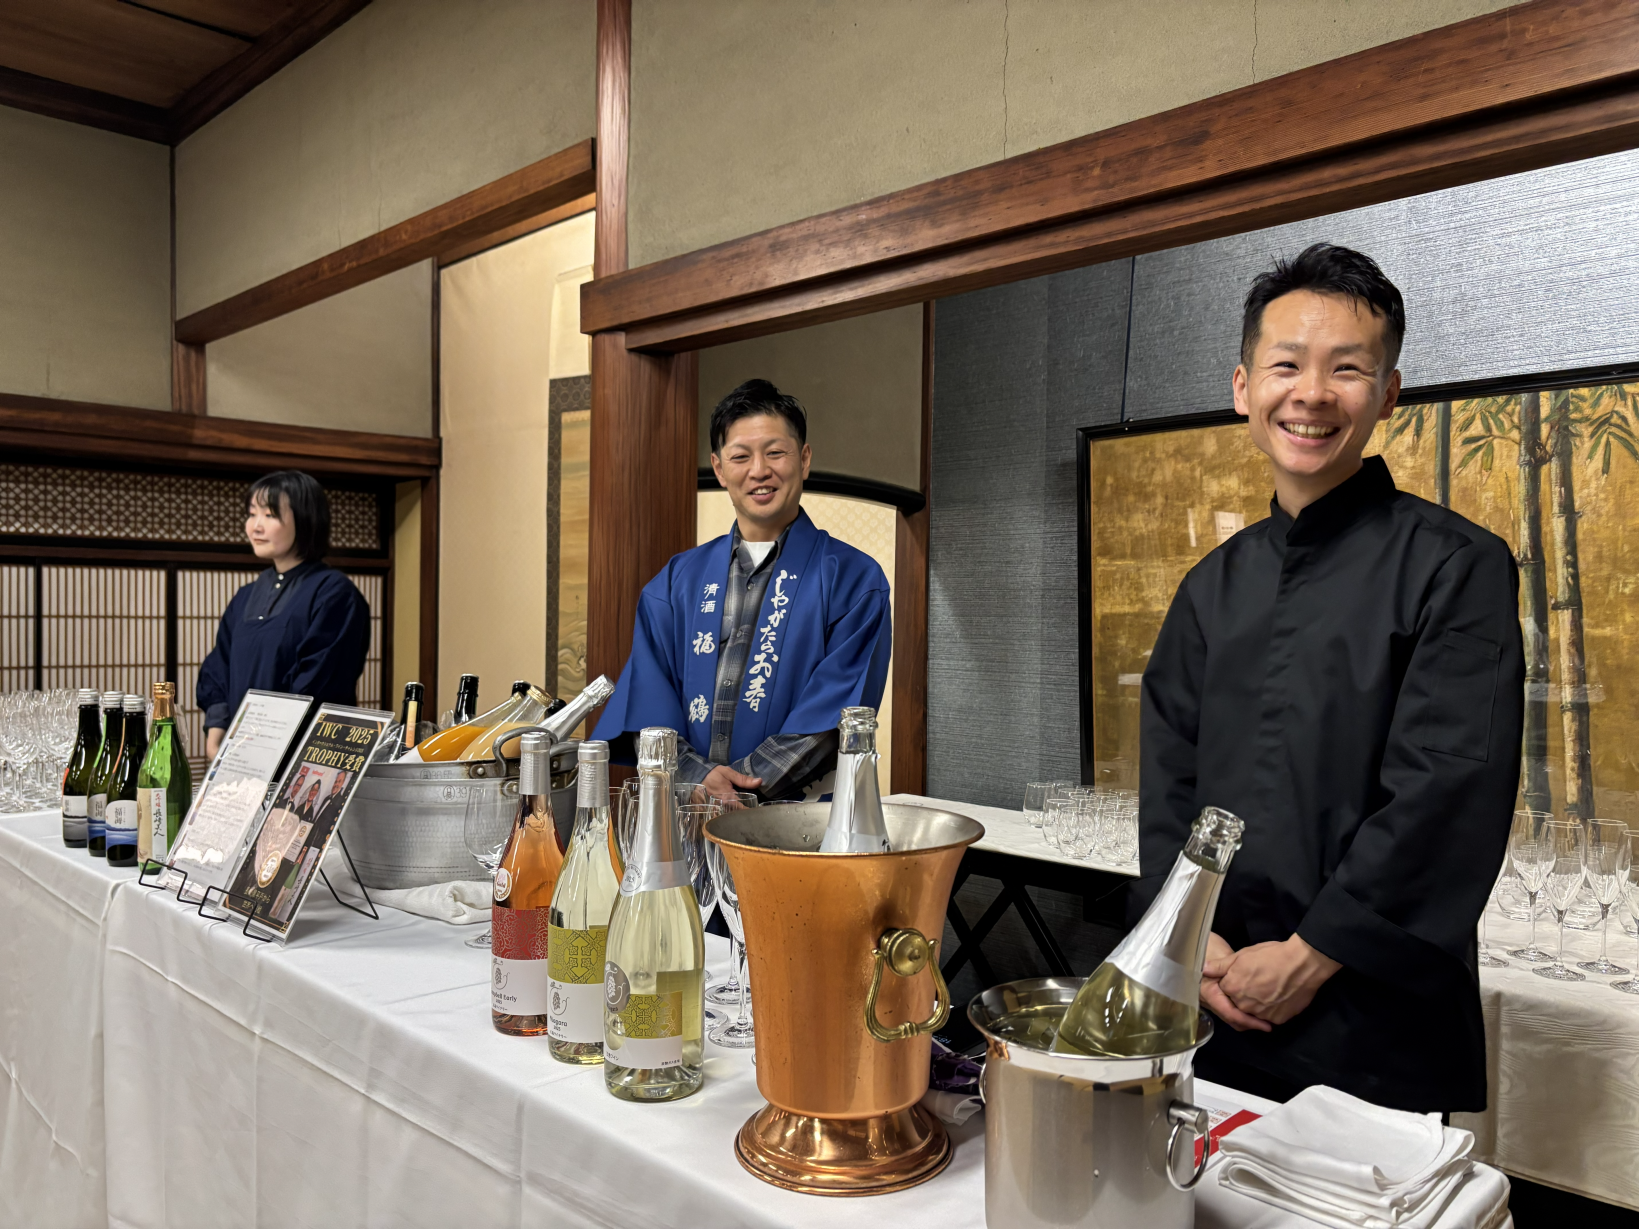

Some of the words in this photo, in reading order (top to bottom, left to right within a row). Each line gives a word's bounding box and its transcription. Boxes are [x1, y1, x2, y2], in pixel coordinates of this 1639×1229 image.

[701, 583, 720, 613] 清酒
[317, 722, 342, 739] IWC
[345, 727, 374, 745] 2025
[304, 746, 365, 772] TROPHY受賞
[503, 993, 517, 1003] Early
